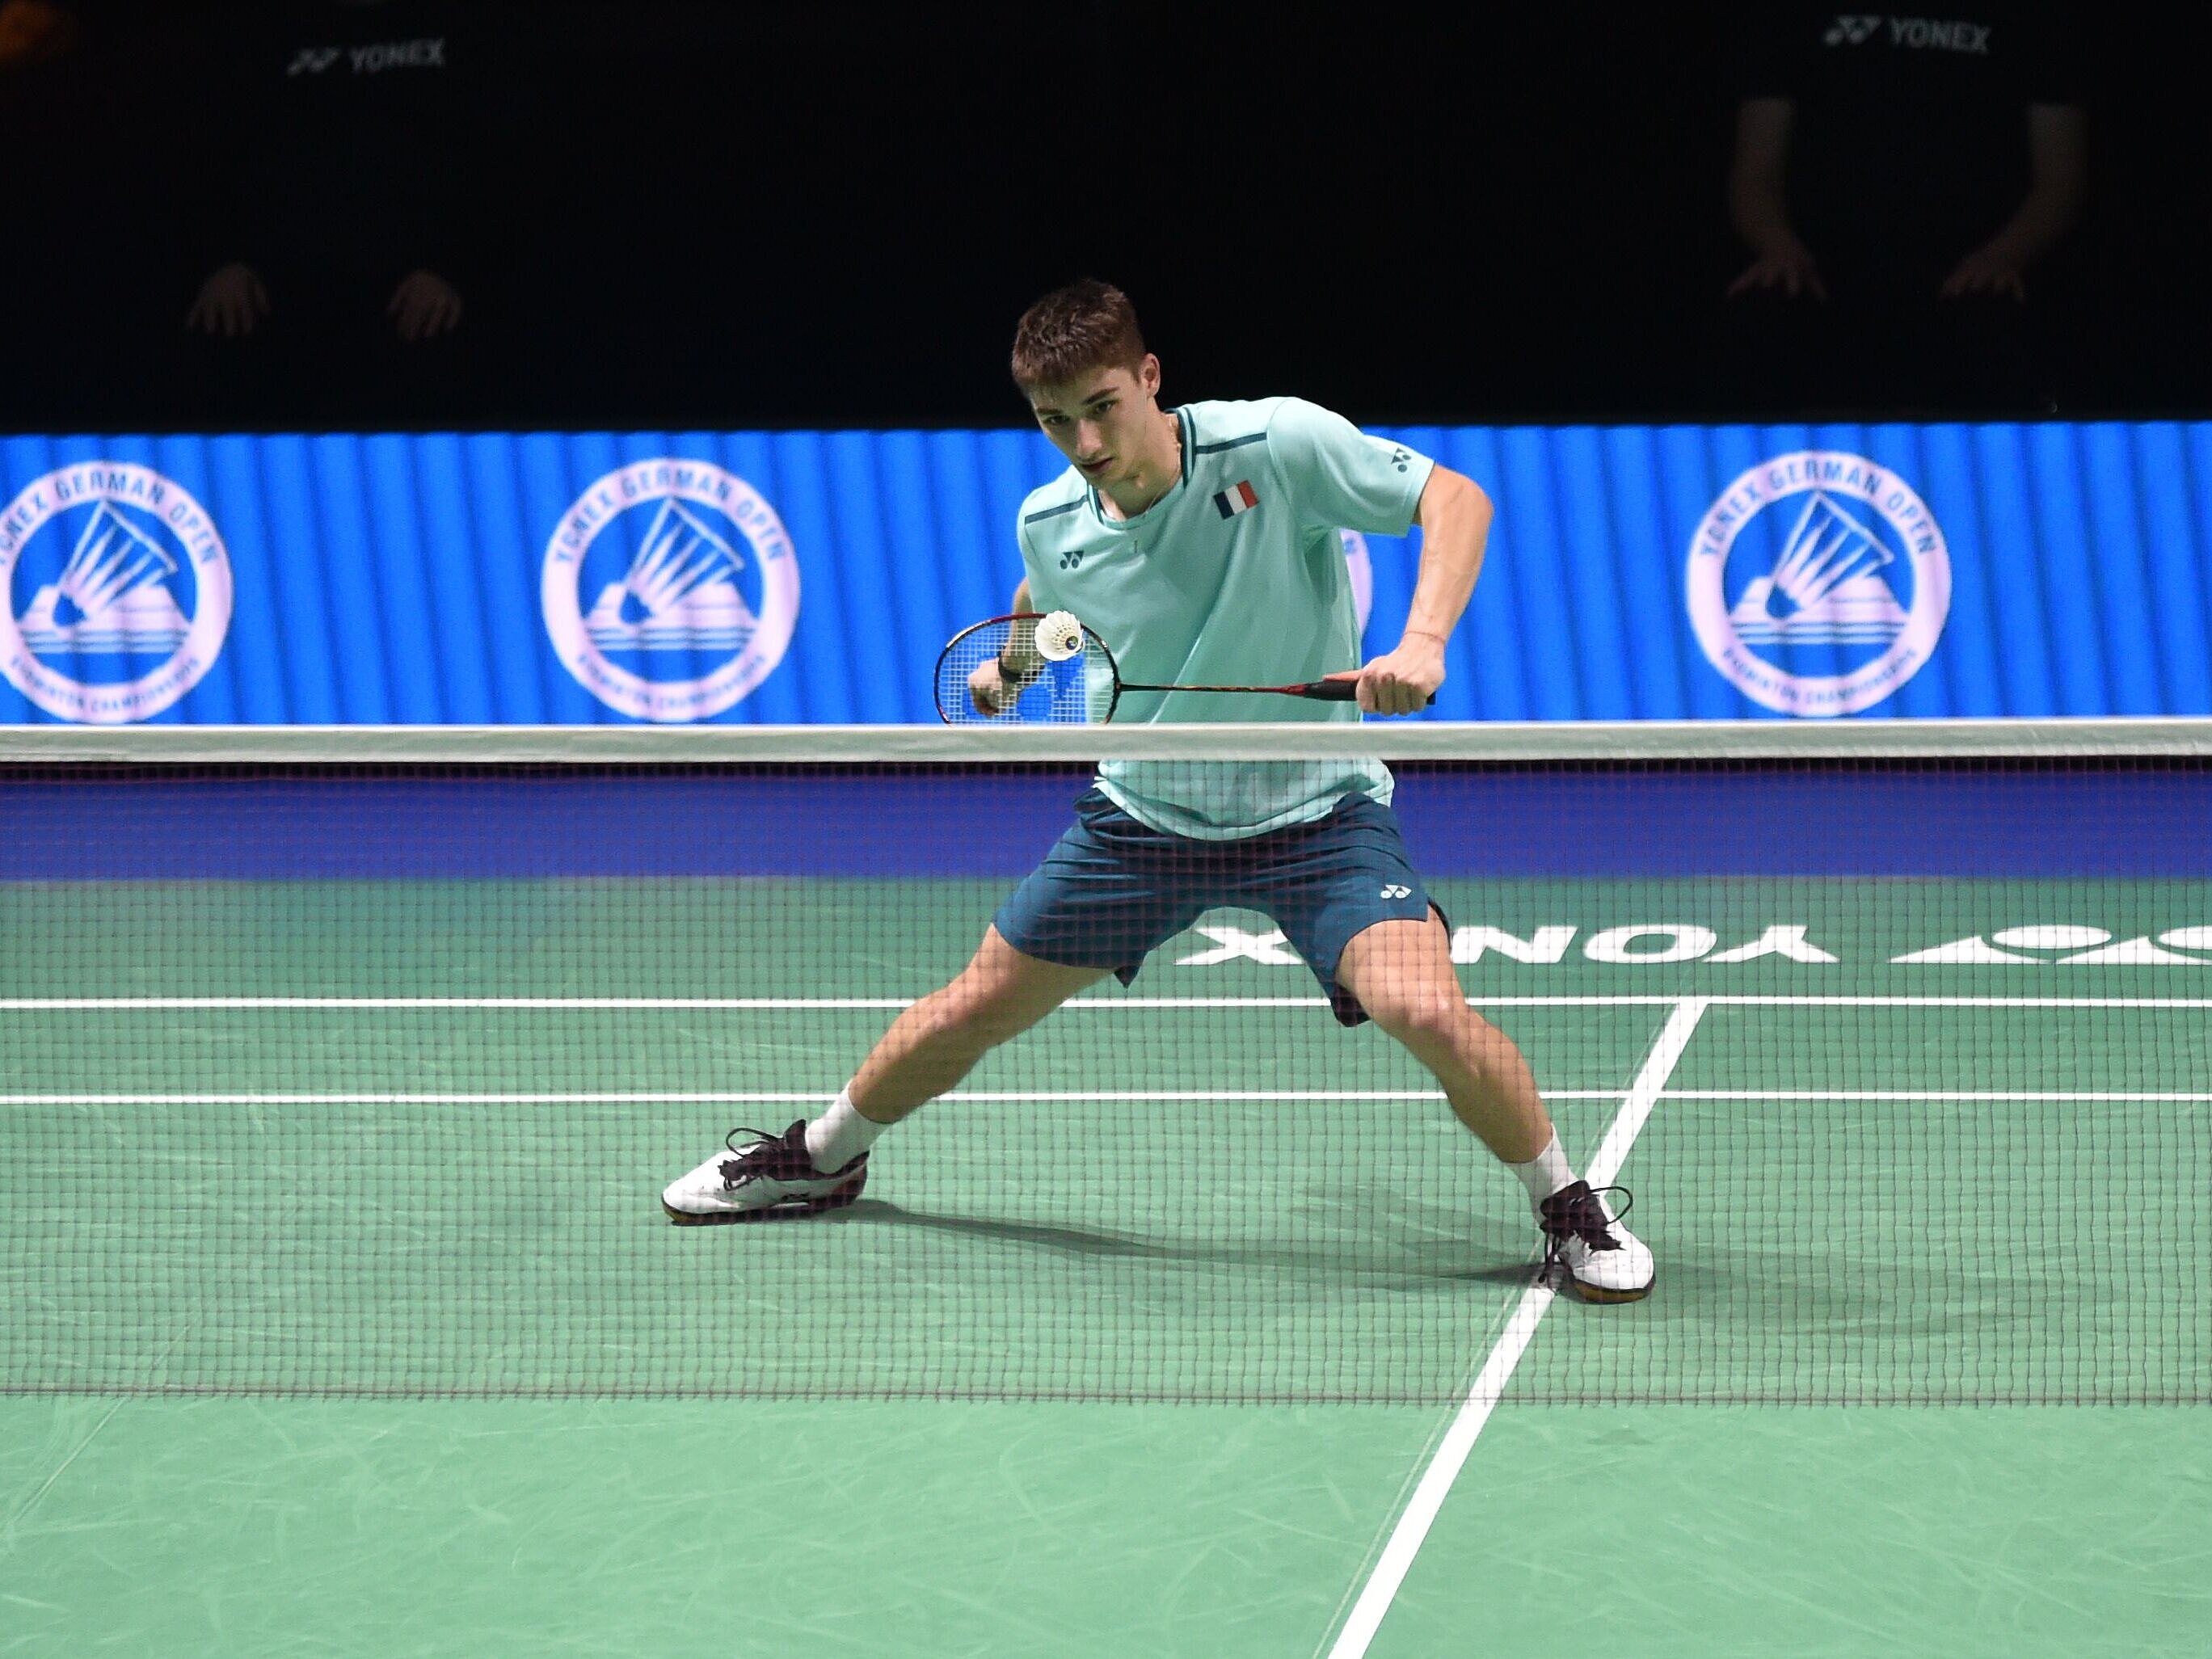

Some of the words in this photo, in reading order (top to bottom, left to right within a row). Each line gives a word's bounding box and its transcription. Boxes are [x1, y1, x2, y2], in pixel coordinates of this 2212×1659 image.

[348, 39, 445, 74] YONEX
[1890, 16, 1991, 54] YONEX
[56, 470, 166, 503] GERMAN
[168, 501, 220, 563] OPEN
[621, 465, 731, 500] GERMAN
[736, 499, 786, 561] OPEN
[1700, 482, 1762, 556] YONEX
[1768, 460, 1882, 495] GERMAN
[1887, 492, 1936, 554] OPEN
[1173, 924, 1840, 965] YONX
